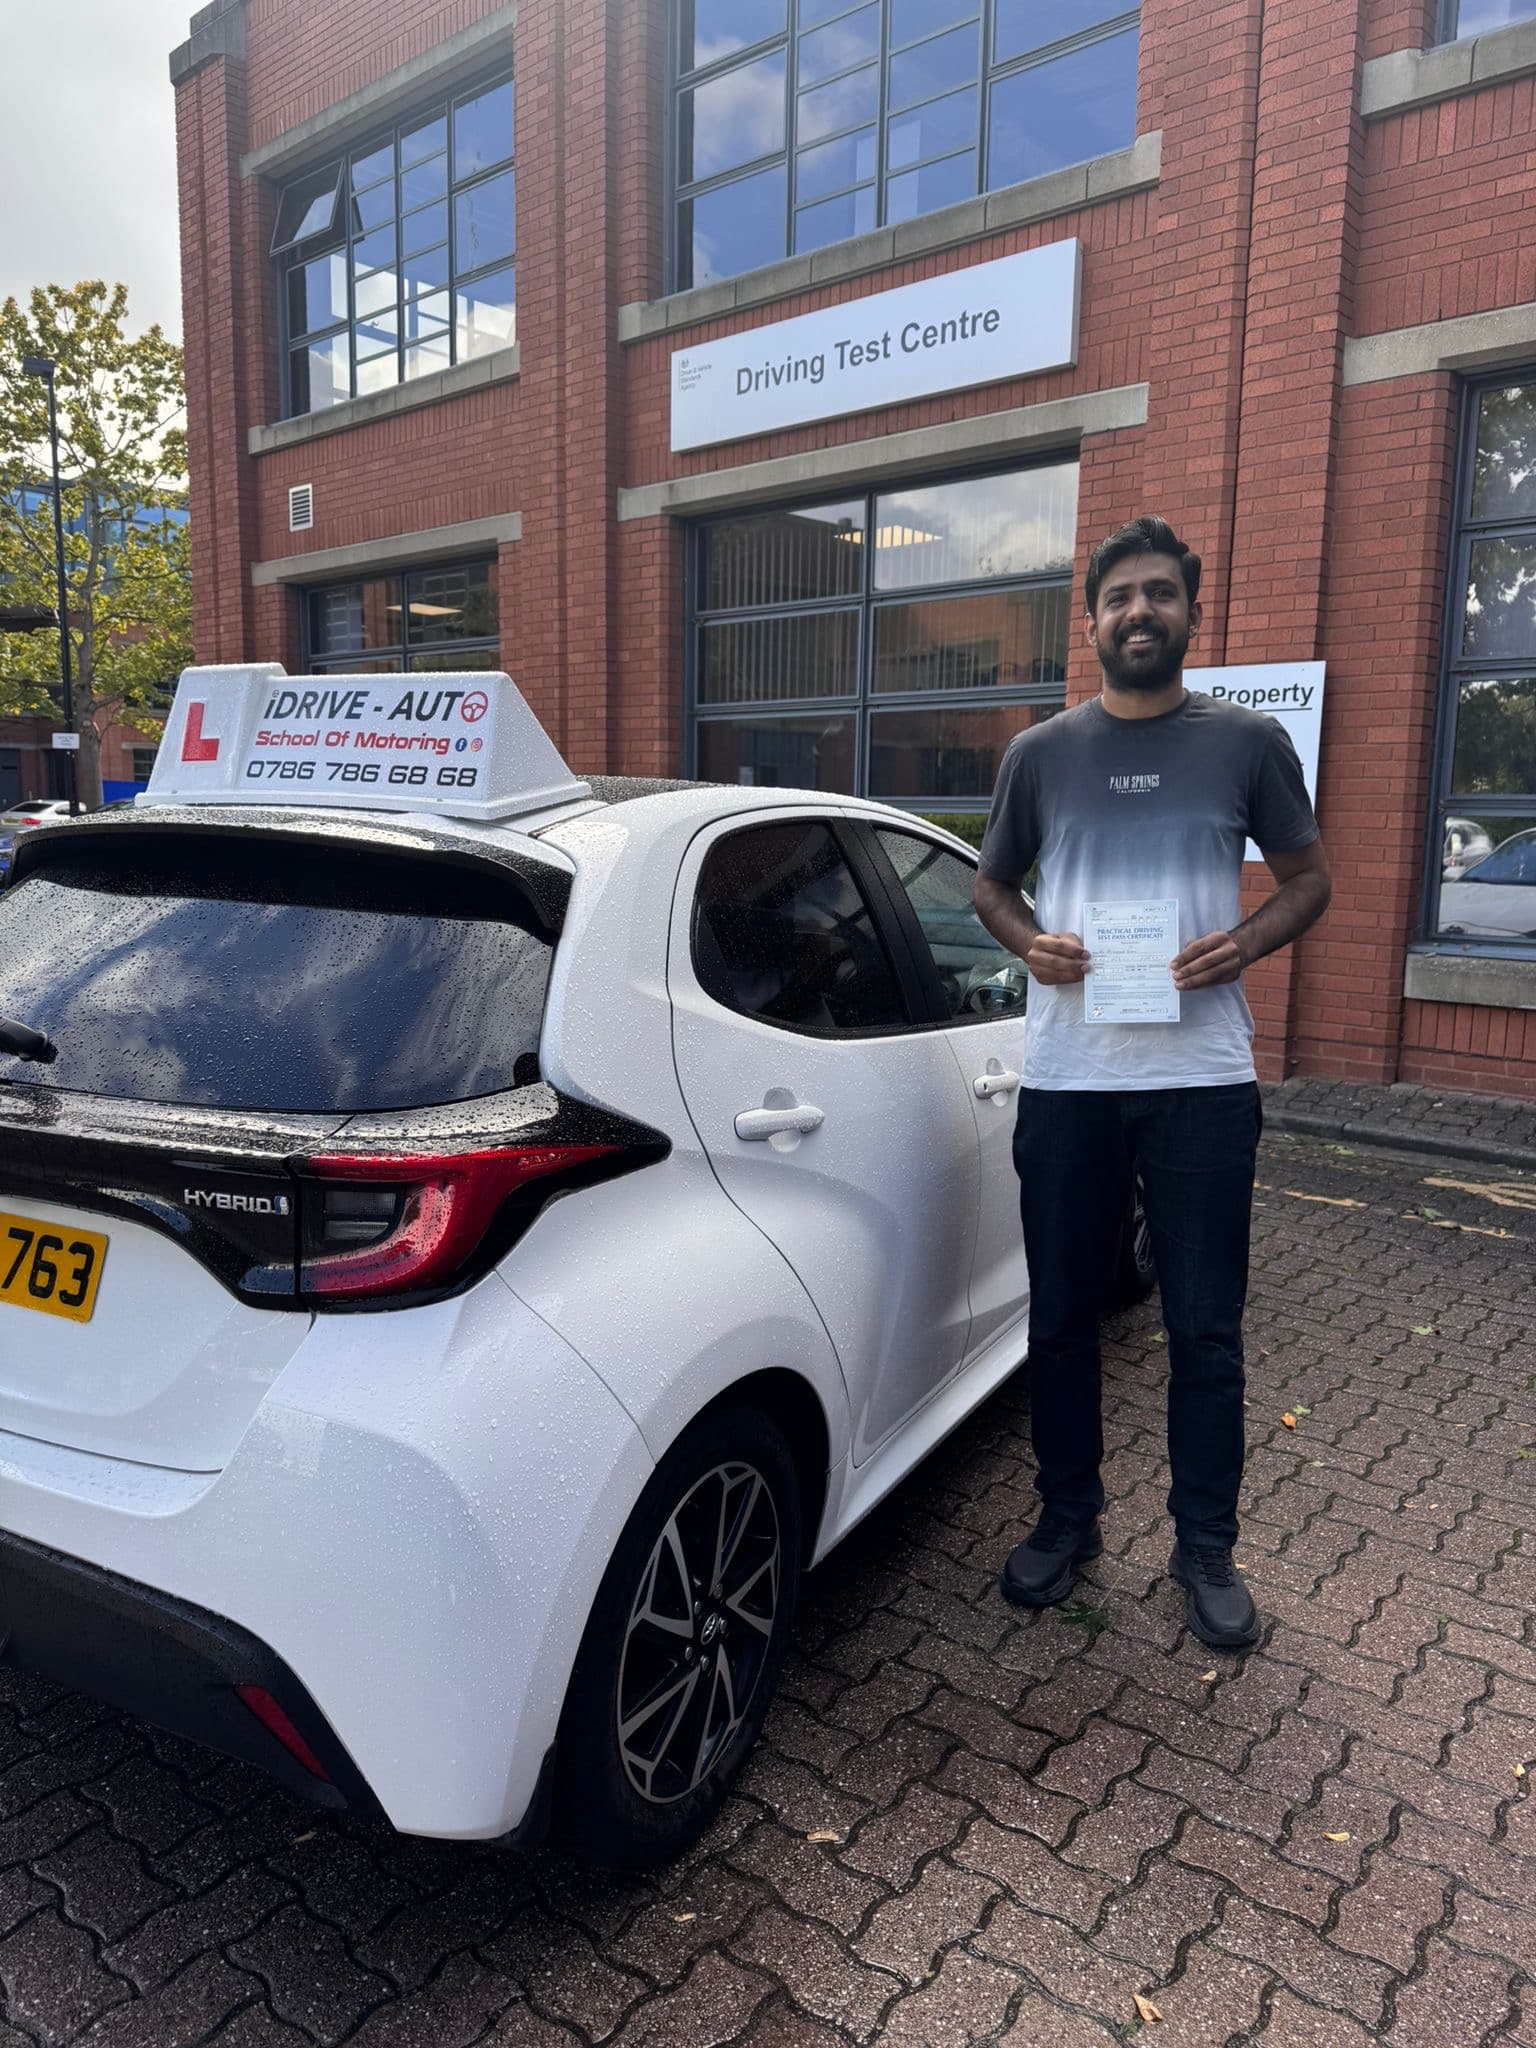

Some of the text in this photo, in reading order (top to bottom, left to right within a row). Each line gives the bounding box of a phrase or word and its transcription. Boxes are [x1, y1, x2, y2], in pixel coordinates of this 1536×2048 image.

[736, 308, 1001, 396] Driving Test Centre
[1212, 683, 1315, 708] Property
[181, 702, 220, 762] L
[255, 730, 321, 747] School
[324, 731, 350, 748] Of
[353, 732, 450, 756] Motoring
[246, 760, 478, 787] 0786 786 68 68
[1109, 774, 1160, 790] PALM SPRINGS
[184, 1189, 275, 1214] HYBRID
[1, 1227, 95, 1307] 763
